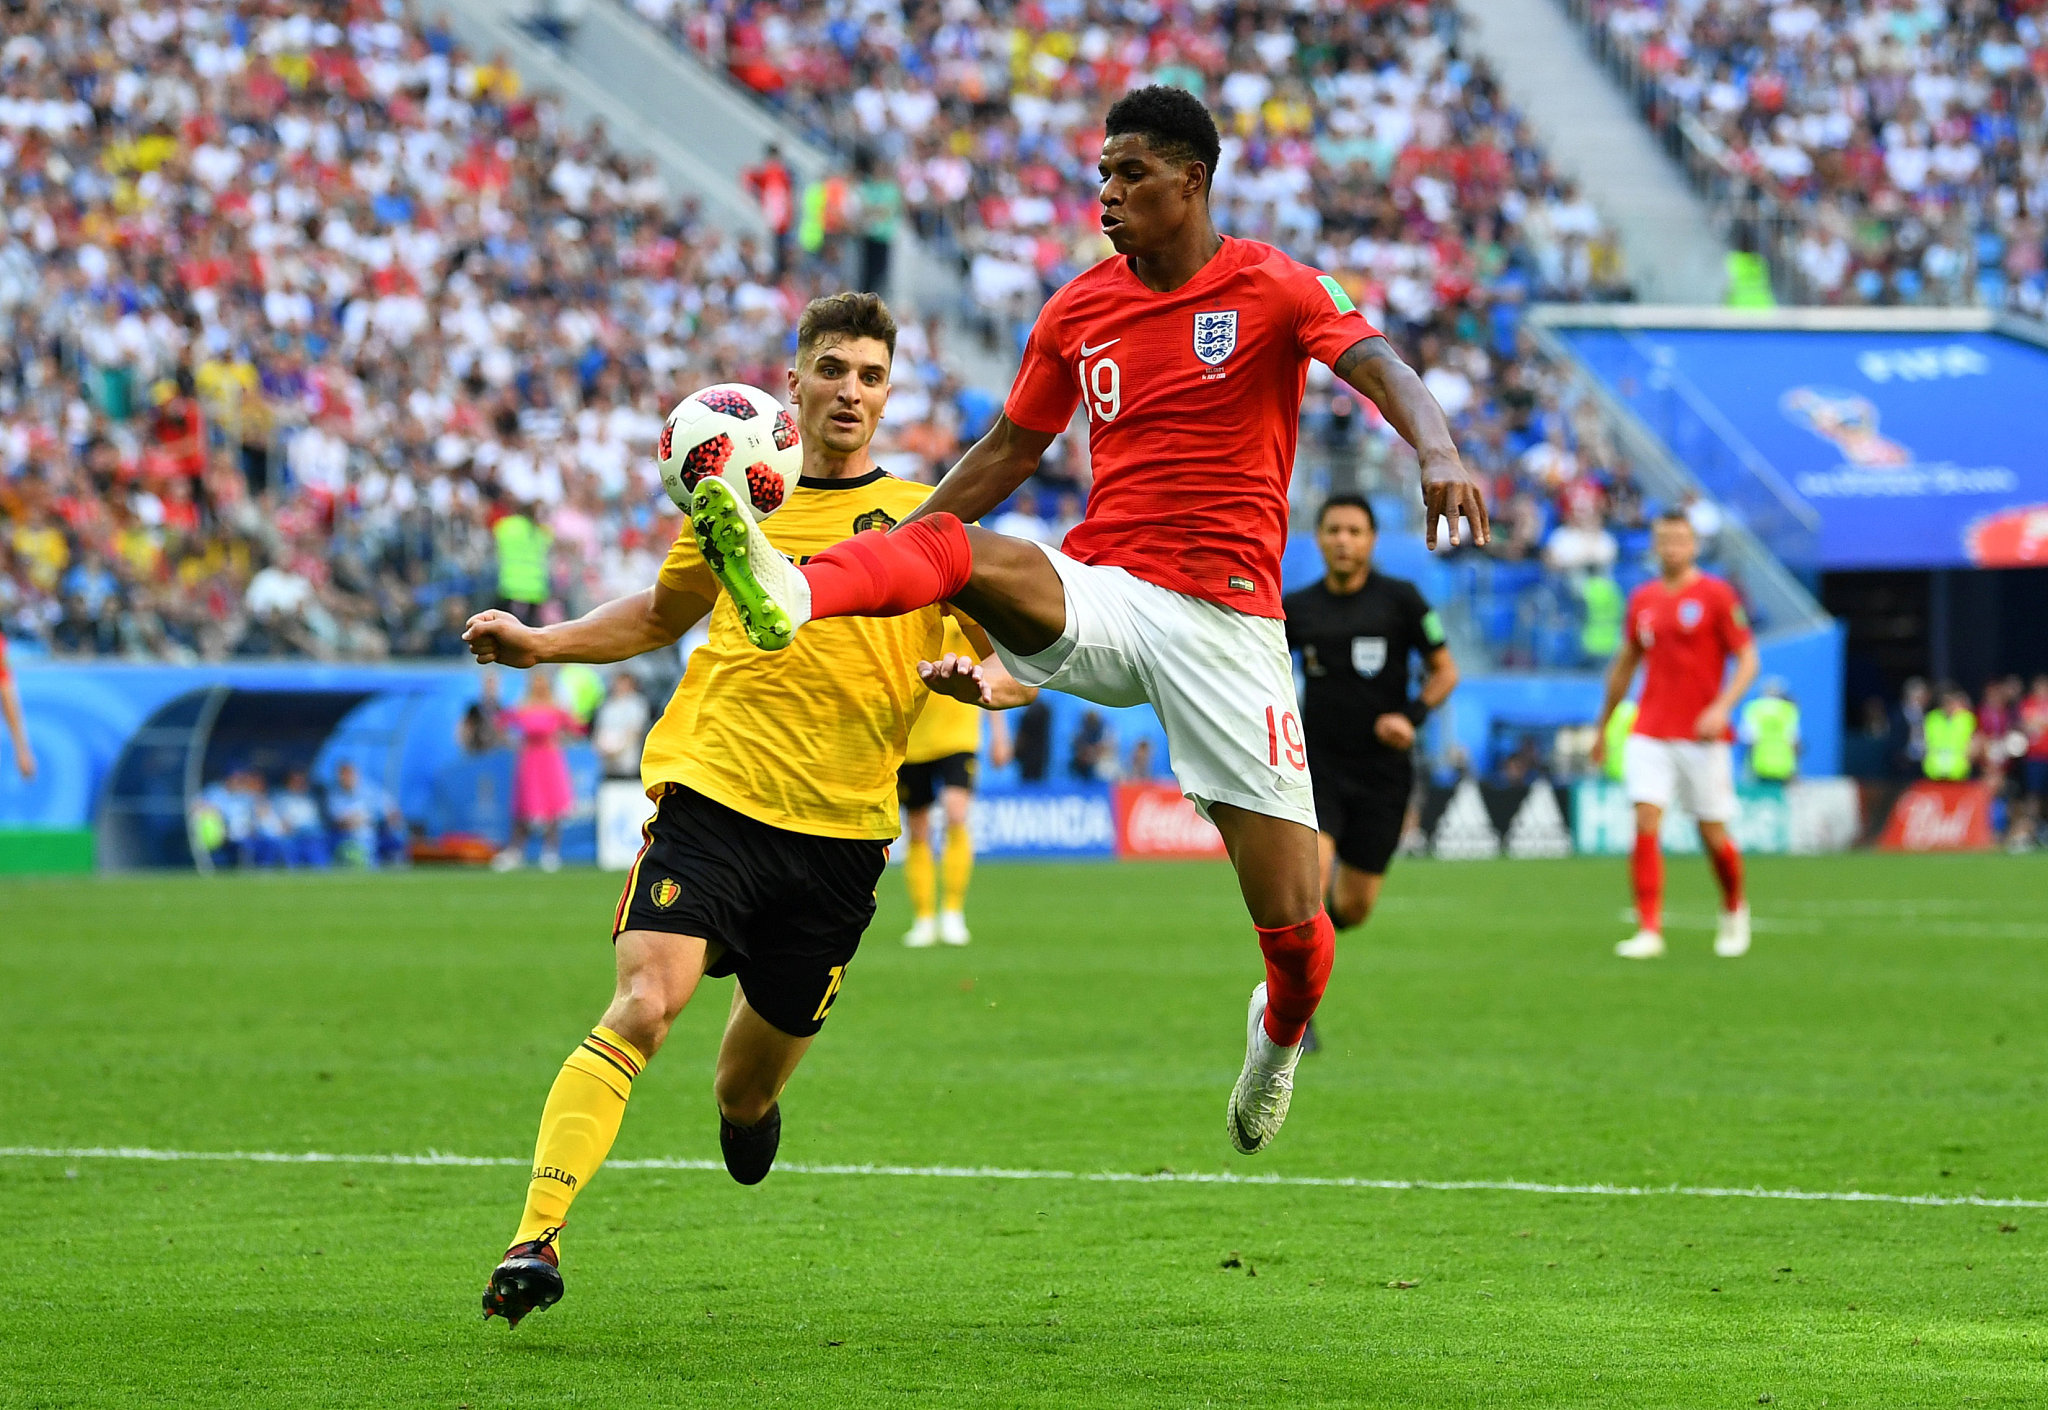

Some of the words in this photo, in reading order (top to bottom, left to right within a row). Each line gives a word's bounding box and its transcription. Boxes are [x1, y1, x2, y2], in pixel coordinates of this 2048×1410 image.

[1079, 358, 1121, 423] 19
[1265, 705, 1306, 772] 19
[532, 1166, 578, 1192] ELGIUM
